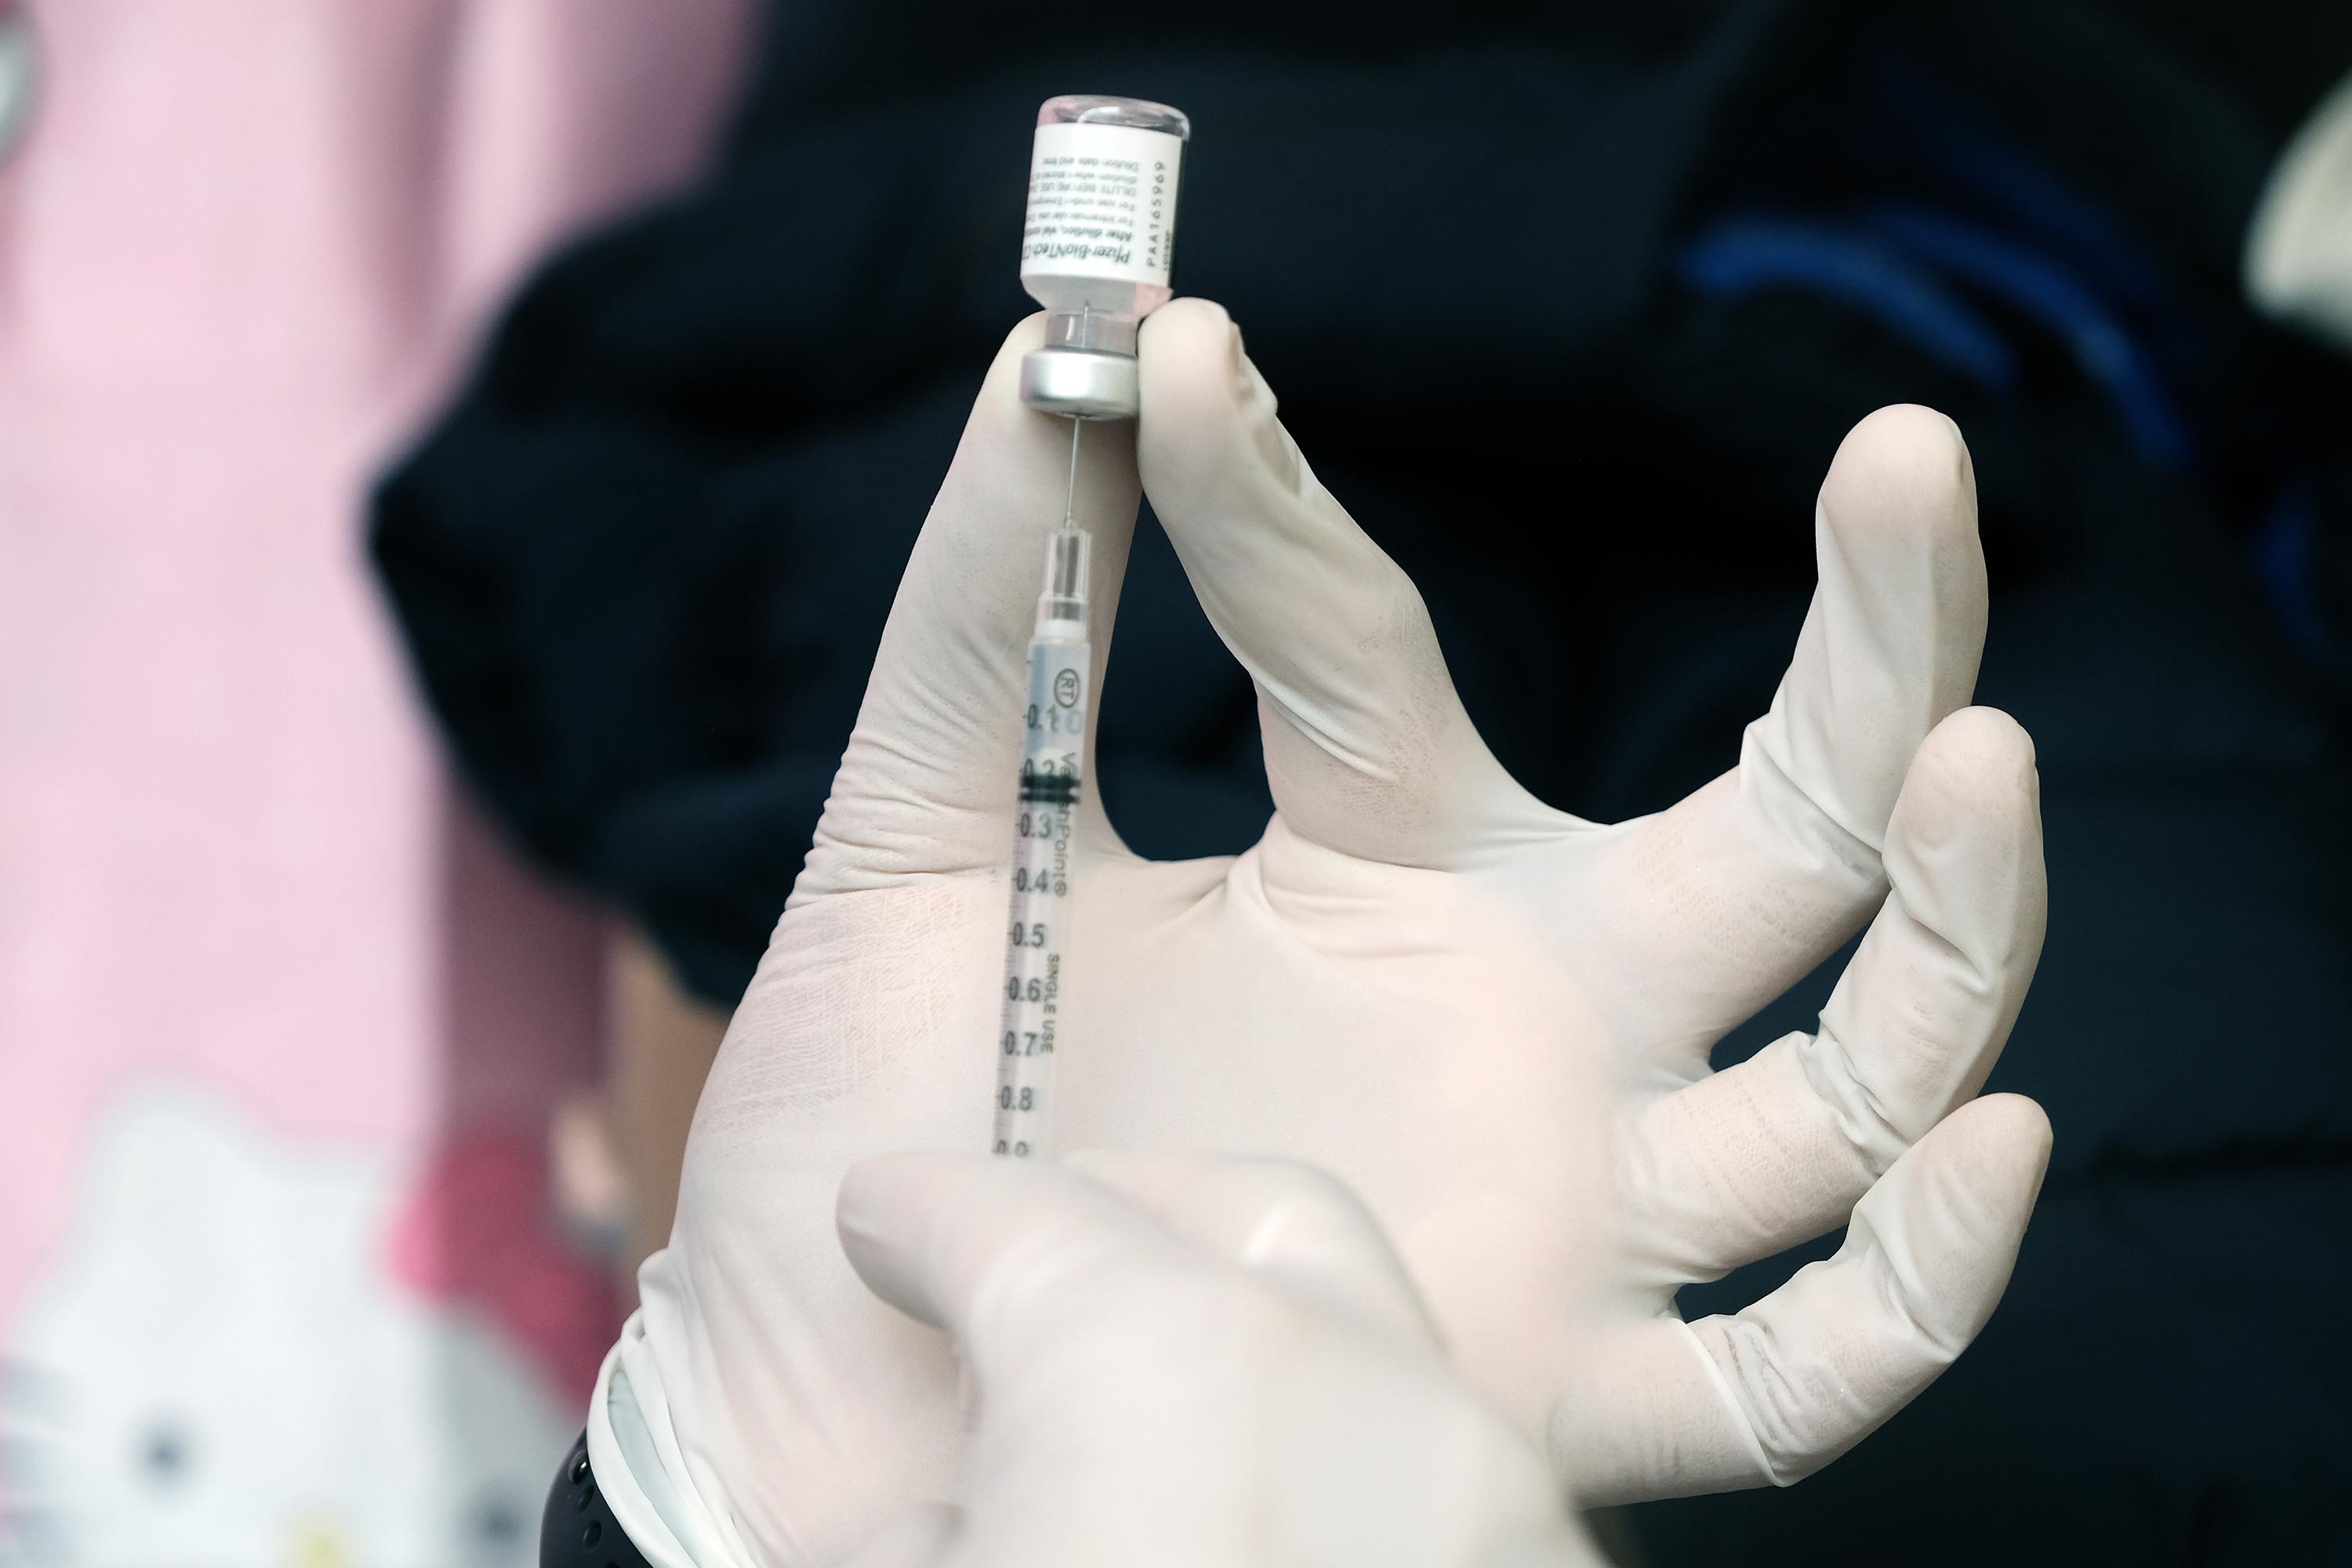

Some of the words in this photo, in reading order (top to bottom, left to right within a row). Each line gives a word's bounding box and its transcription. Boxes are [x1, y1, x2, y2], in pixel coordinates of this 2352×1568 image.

[1146, 161, 1166, 267] PAA165969
[1105, 230, 1132, 242] After
[1019, 813, 1052, 839] 0.3
[1016, 866, 1049, 893] 0.4
[1012, 921, 1045, 948] 0.5
[1008, 975, 1041, 1002] 0.6
[1044, 953, 1060, 1014] SINGLE
[1004, 1030, 1037, 1056] 0.7
[1040, 1019, 1054, 1053] USE
[1000, 1085, 1033, 1112] 0.8
